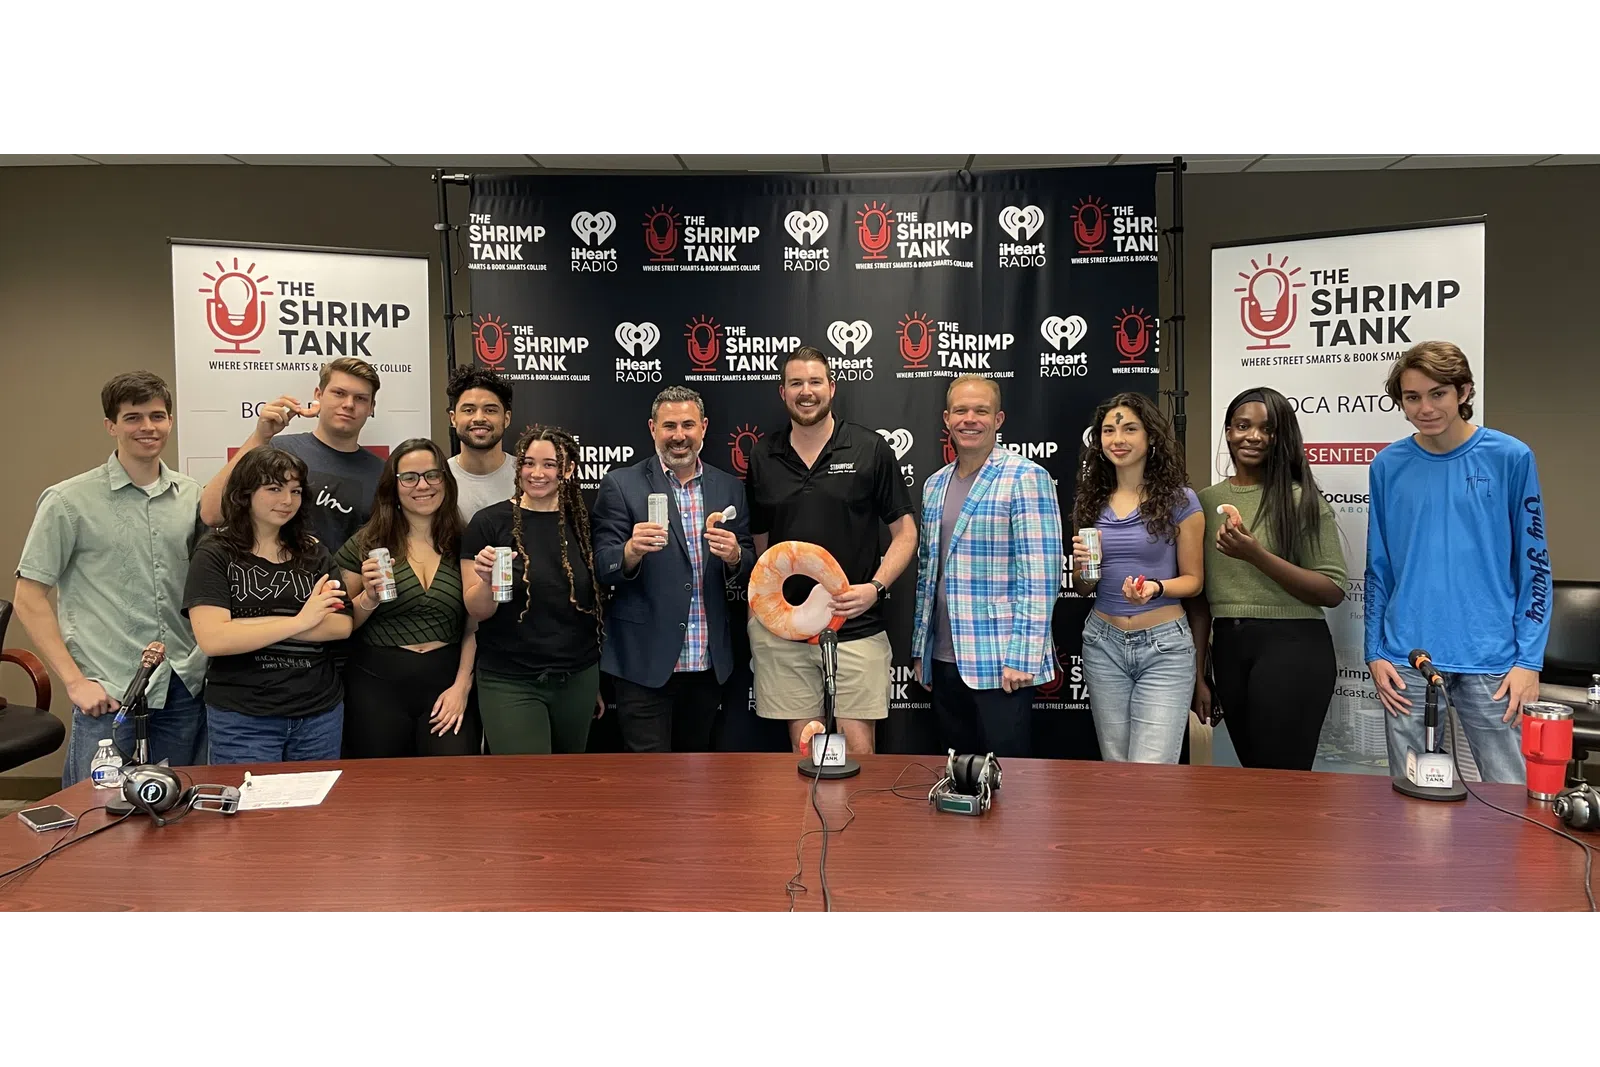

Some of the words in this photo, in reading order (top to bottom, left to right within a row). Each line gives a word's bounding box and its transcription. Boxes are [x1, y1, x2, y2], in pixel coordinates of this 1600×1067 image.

[896, 212, 918, 222] THE
[1112, 206, 1134, 216] THE
[469, 213, 491, 224] THE
[684, 216, 705, 225] THE
[469, 225, 546, 242] SHRIMP
[684, 226, 760, 243] SHRIMP
[897, 221, 973, 240] SHRIMP
[469, 243, 523, 260] TANK
[571, 247, 617, 260] iHeart
[684, 245, 737, 262] TANK
[784, 246, 829, 259] iHeart
[896, 240, 950, 258] TANK
[999, 242, 1045, 256] iHeart
[571, 260, 618, 272] RADIO
[784, 260, 830, 271] RADIO
[953, 260, 974, 268] COLLIDE
[999, 256, 1046, 268] RADIO
[1090, 256, 1108, 264] STREET
[1310, 268, 1349, 286] THE
[277, 281, 315, 297] THE
[1310, 279, 1461, 316] SHRIMP
[279, 299, 411, 328] SHRIMP
[512, 325, 534, 335] THE
[725, 326, 746, 336] THE
[938, 322, 959, 332] THE
[1310, 315, 1412, 347] TANK
[278, 329, 372, 357] TANK
[514, 336, 589, 354] SHRIMP
[726, 337, 801, 354] SHRIMP
[938, 332, 1014, 350] SHRIMP
[209, 360, 241, 370] WHERE
[243, 361, 274, 371] STREET
[276, 362, 310, 371] SMARTS
[312, 363, 319, 371] &
[514, 354, 567, 371] TANK
[616, 358, 661, 370] iHeart
[726, 355, 778, 371] TANK
[828, 357, 873, 369] iHeart
[938, 350, 991, 368] TANK
[1040, 352, 1088, 365] iHeart
[1241, 357, 1271, 367] WHERE
[1273, 356, 1304, 366] STREET
[1306, 354, 1342, 364] SMARTS
[1344, 353, 1351, 362] &
[1353, 352, 1378, 362] BOOK
[380, 364, 412, 373] COLLIDE
[1040, 365, 1088, 377] RADIO
[616, 371, 662, 382] RADIO
[1287, 396, 1330, 414] OCA
[1338, 395, 1402, 413] RATO
[580, 446, 634, 462] RIMP
[1304, 448, 1376, 462] SENTED
[1321, 490, 1369, 504] ocuse
[1524, 494, 1544, 541] Guy
[1525, 548, 1551, 624] Harvey
[1336, 667, 1370, 682] rimp
